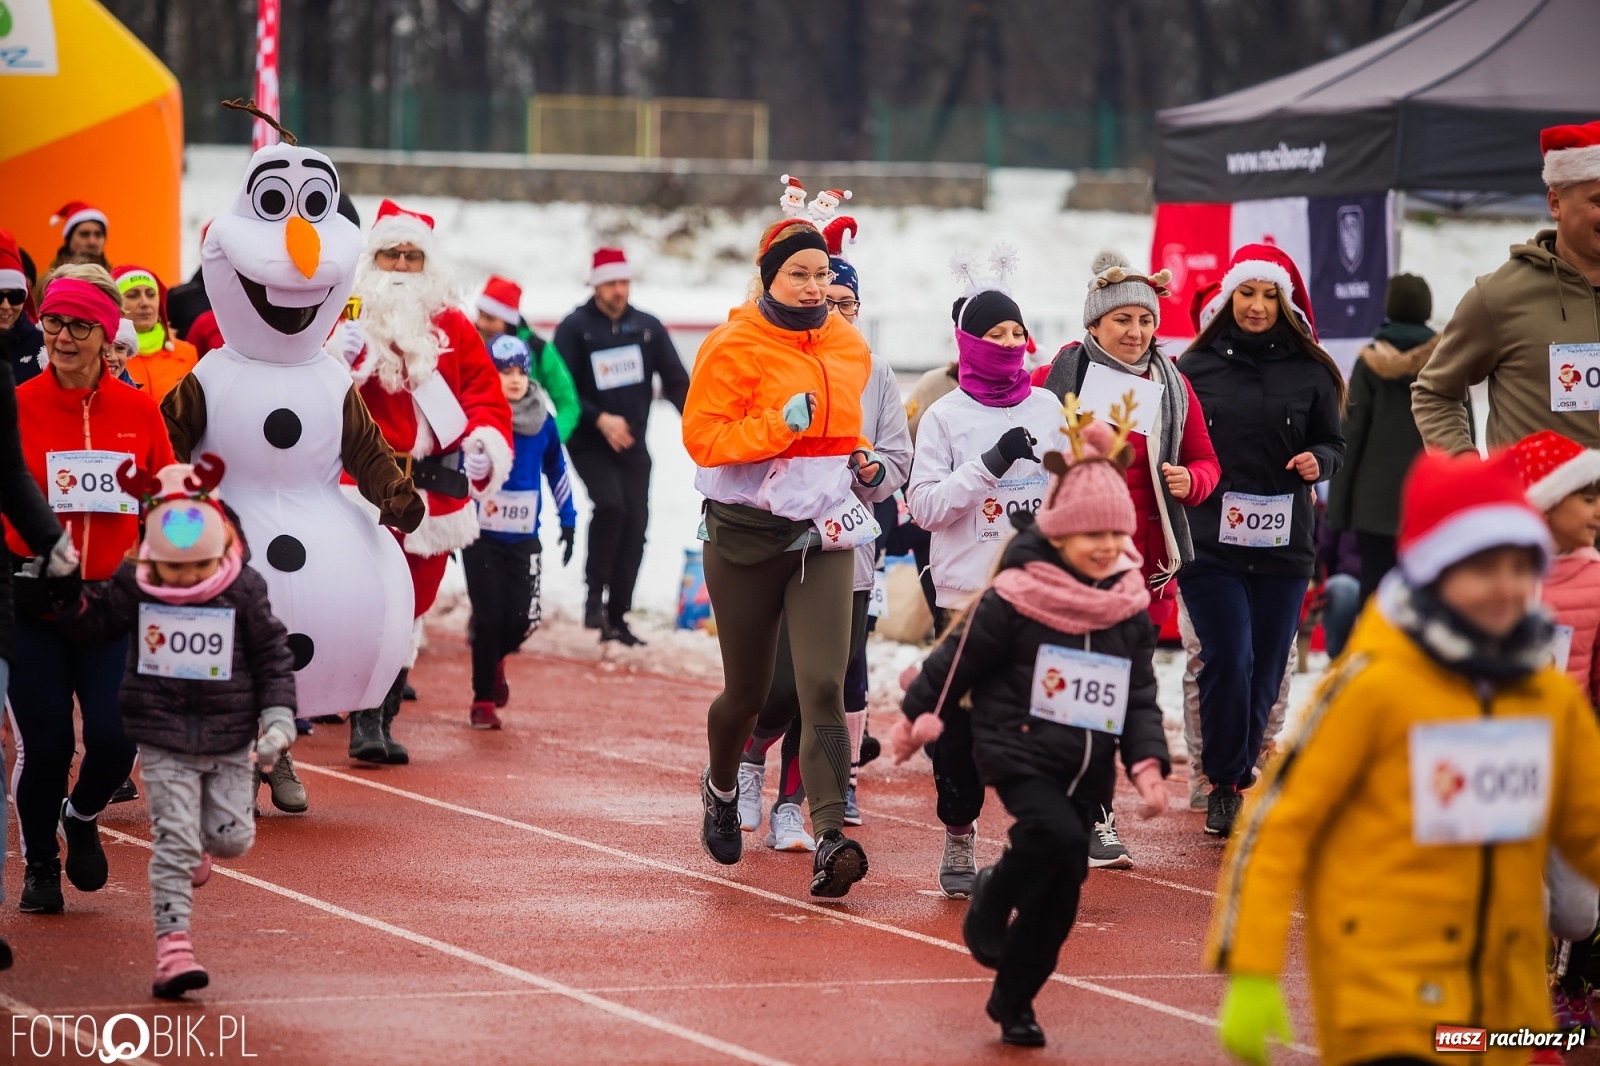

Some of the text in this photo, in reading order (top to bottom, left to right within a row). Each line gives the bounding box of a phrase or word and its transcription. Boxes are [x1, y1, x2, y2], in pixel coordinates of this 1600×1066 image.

[81, 473, 126, 493] 08
[501, 505, 529, 520] 189
[841, 503, 869, 532] 037
[1246, 512, 1286, 531] 029
[170, 631, 223, 655] 009
[1072, 678, 1116, 707] 185
